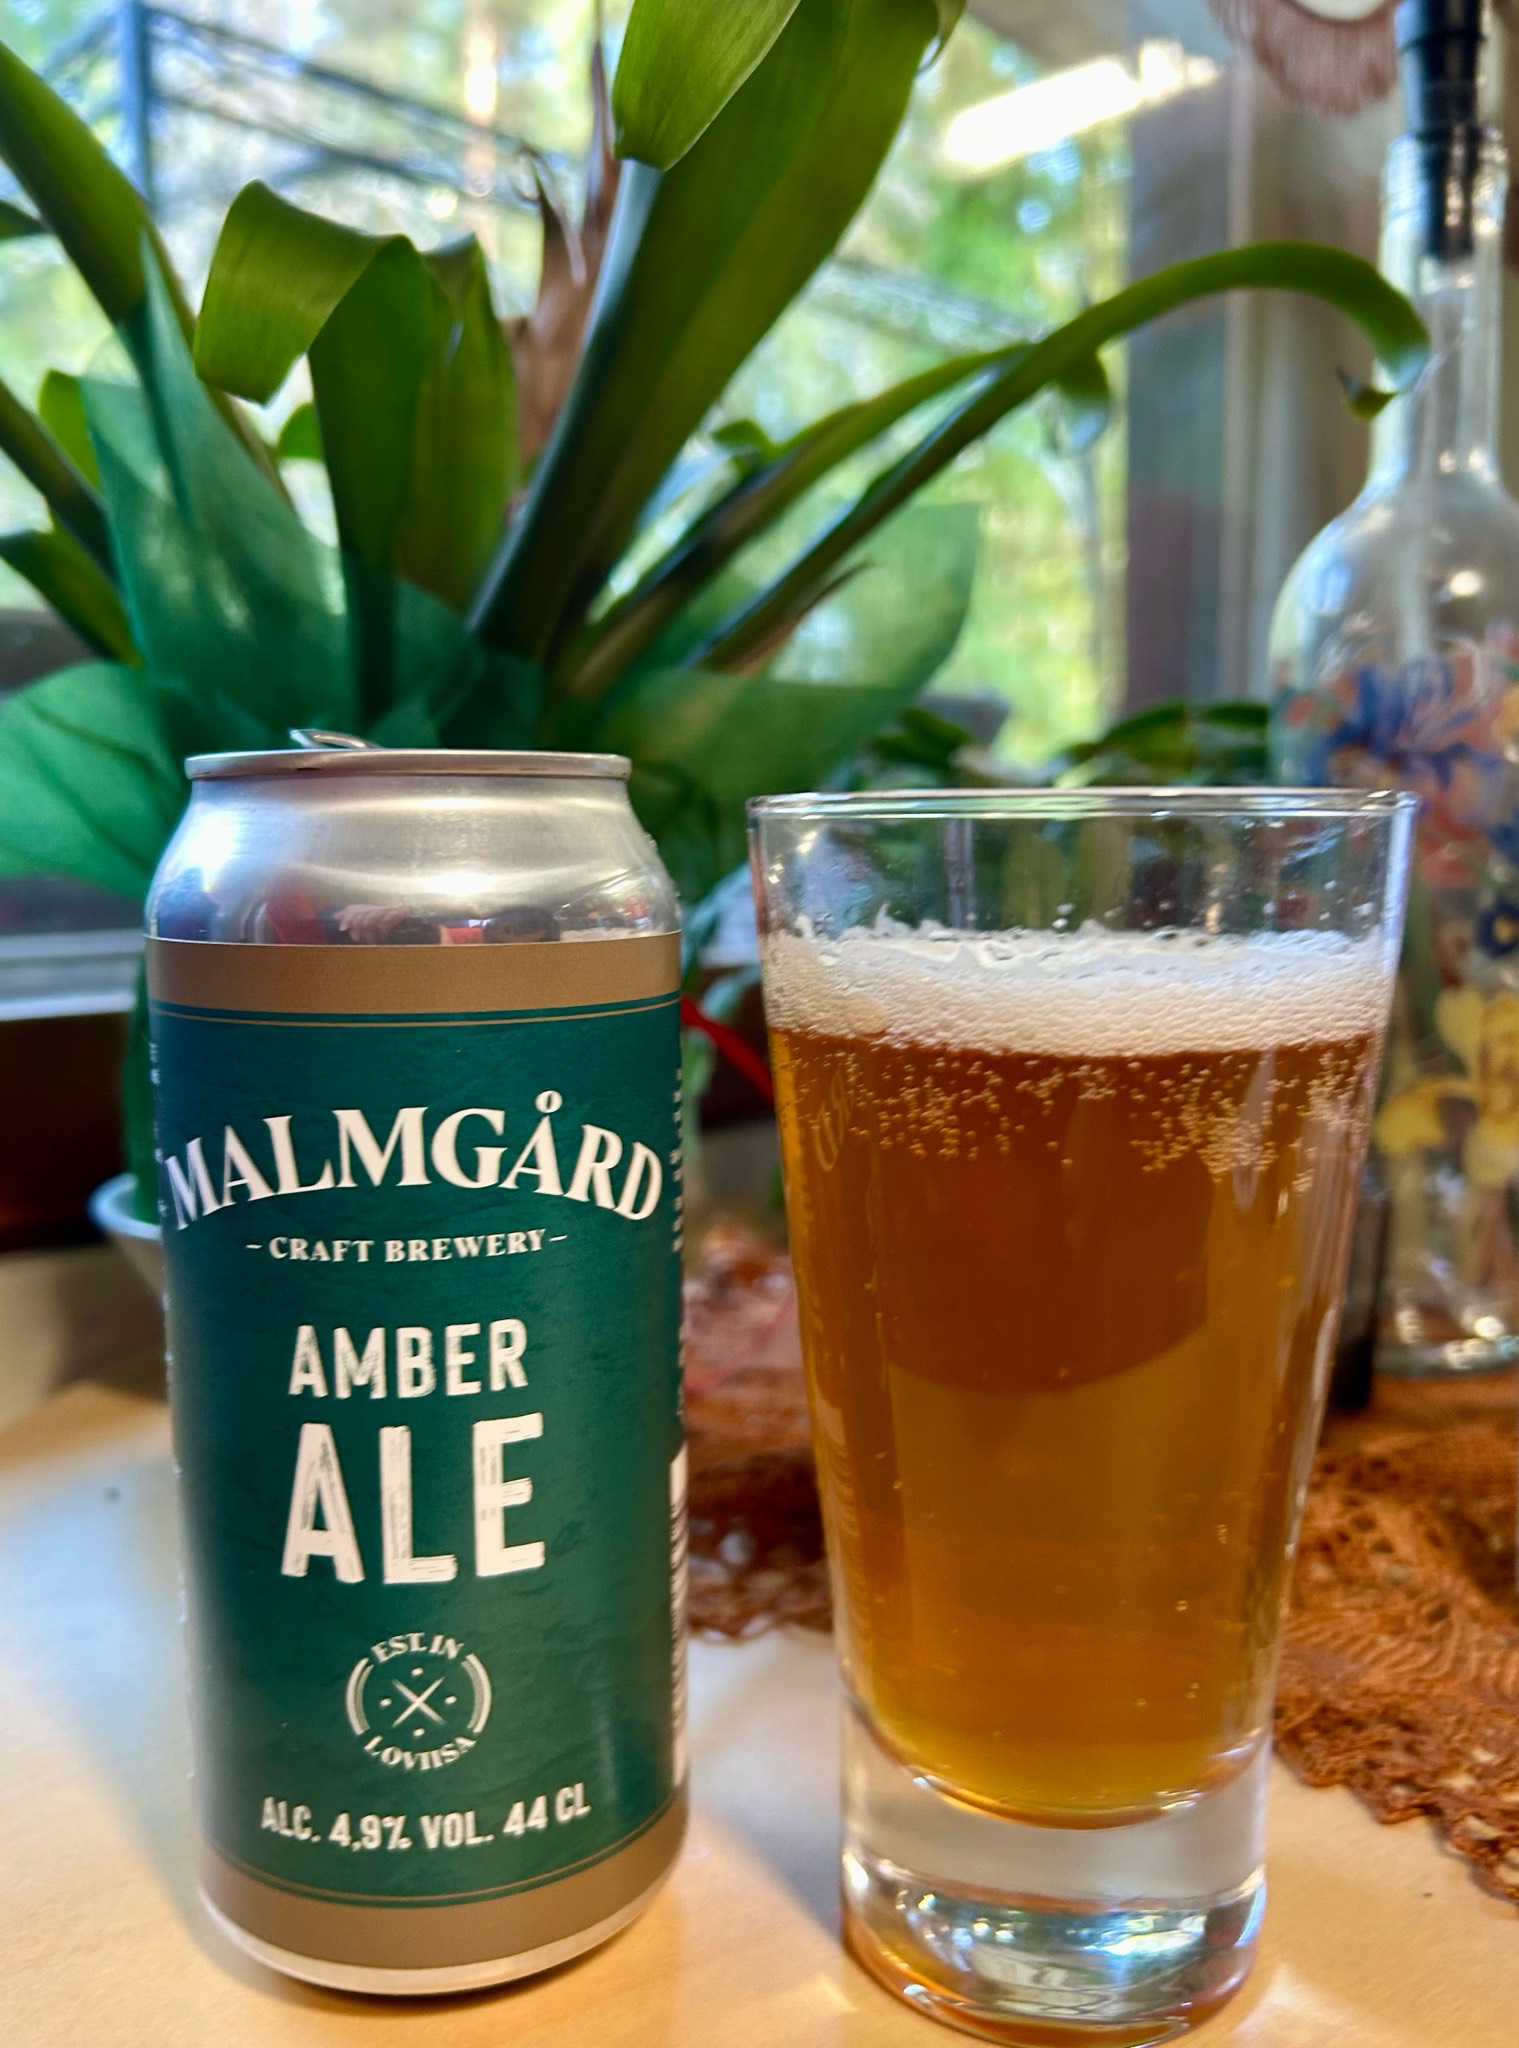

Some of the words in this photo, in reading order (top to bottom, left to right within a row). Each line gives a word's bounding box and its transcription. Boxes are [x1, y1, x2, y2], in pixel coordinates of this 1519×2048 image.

[165, 1089, 663, 1231] MALMGÅRD
[268, 1236, 375, 1263] CRAFT
[384, 1228, 546, 1263] BREWERY
[288, 1318, 528, 1400] AMBER
[281, 1411, 546, 1585] ALE
[428, 1633, 464, 1661] IN
[363, 1734, 478, 1771] LOVIISA
[261, 1796, 321, 1842] ALC.
[328, 1811, 413, 1852] 4,9%
[420, 1810, 494, 1850] VOL.
[502, 1794, 548, 1836] 44
[555, 1781, 592, 1823] CL
